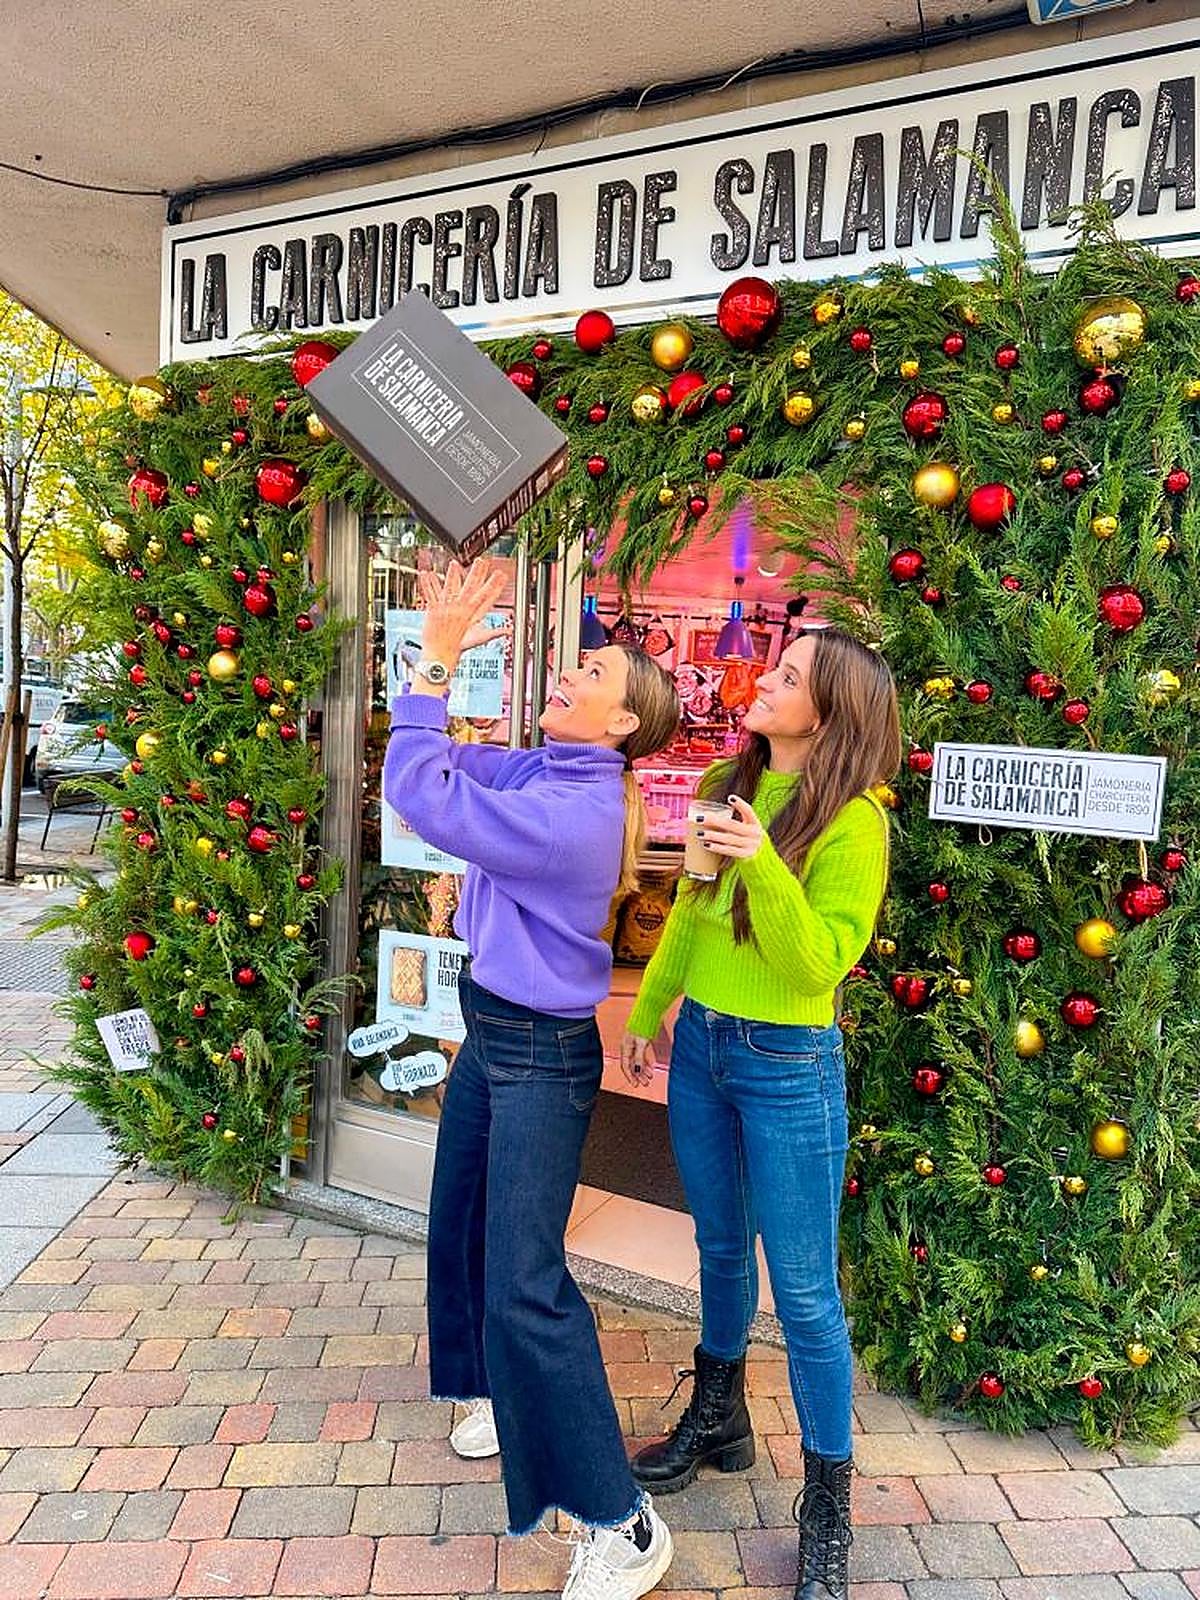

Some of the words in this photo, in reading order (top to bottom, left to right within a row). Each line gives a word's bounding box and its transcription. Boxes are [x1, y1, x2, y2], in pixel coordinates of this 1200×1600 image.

[181, 253, 228, 344] LA
[250, 183, 559, 332] CARNICERÍA
[593, 170, 678, 289] DE
[711, 76, 1197, 272] SALAMANCA
[363, 359, 389, 385] DE
[378, 342, 405, 369] LA
[394, 356, 465, 430] CARNICERÍA
[375, 374, 448, 447] SALAMANCA
[944, 781, 965, 806] DE
[970, 784, 1079, 818] SALAMANCA
[945, 755, 965, 781] LA
[972, 757, 1083, 791] CARNICERÍA
